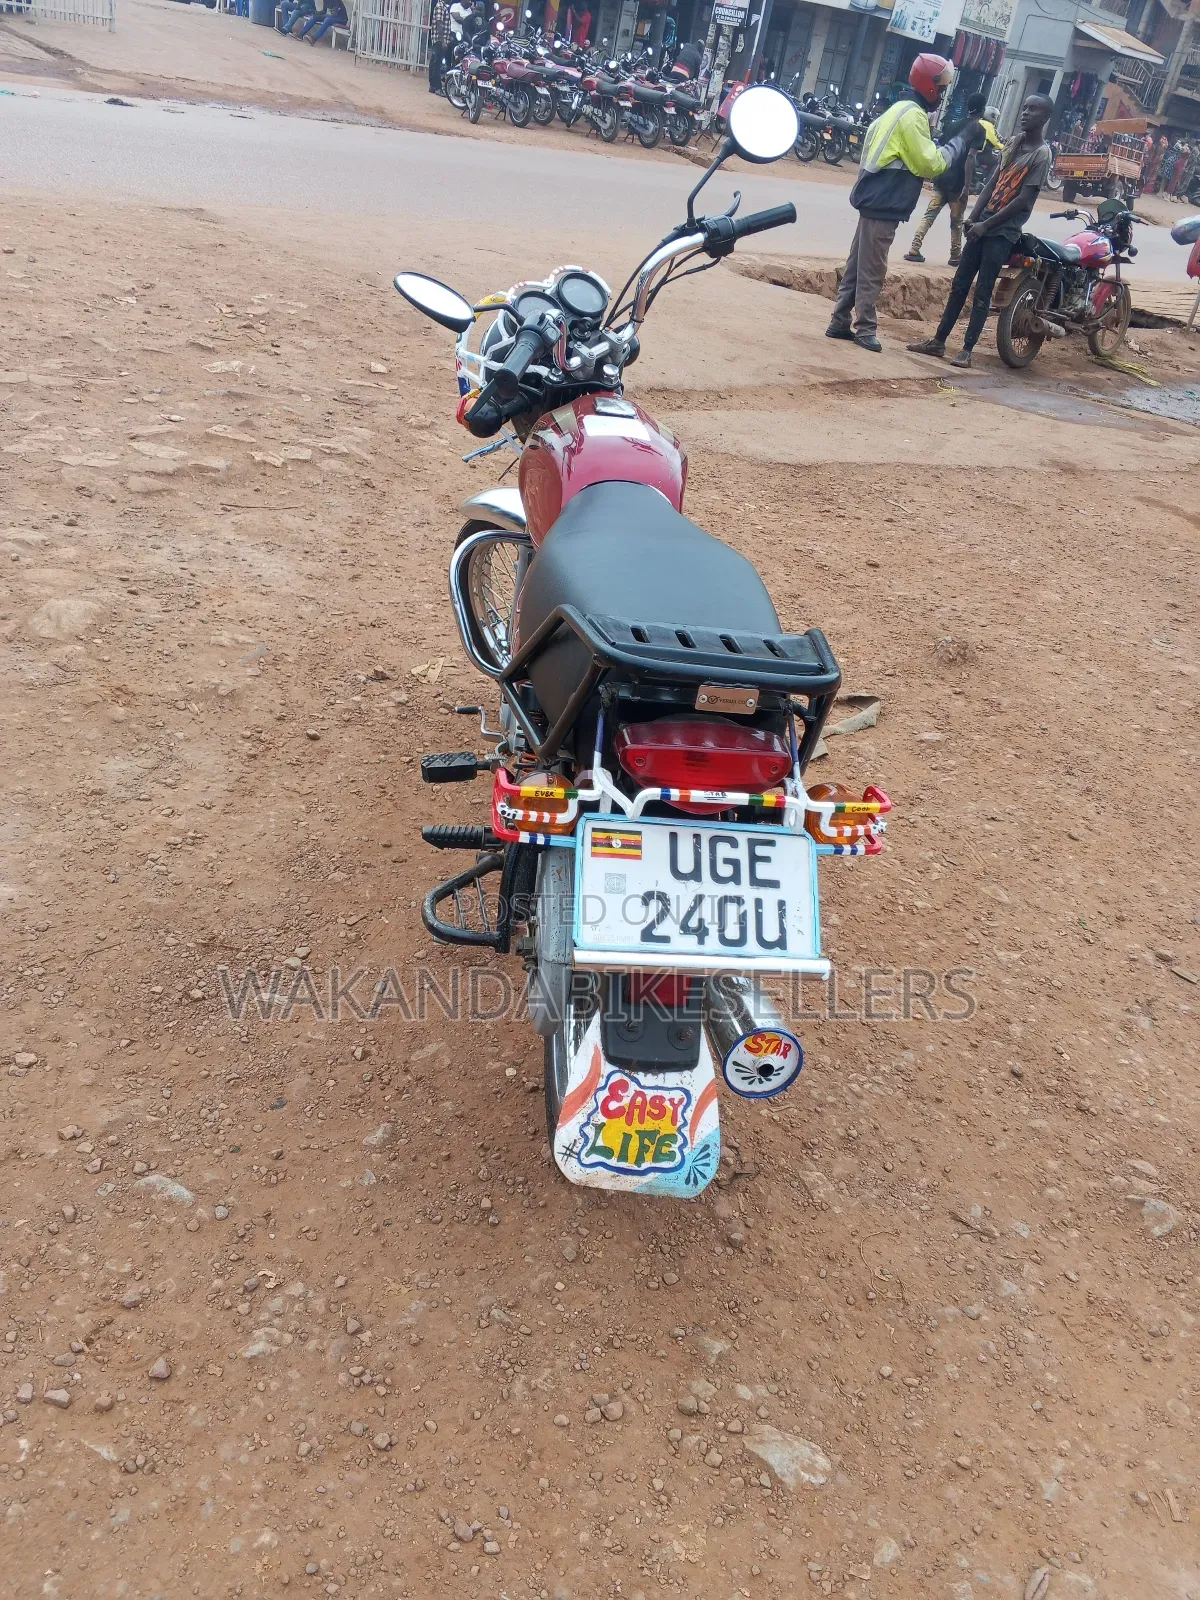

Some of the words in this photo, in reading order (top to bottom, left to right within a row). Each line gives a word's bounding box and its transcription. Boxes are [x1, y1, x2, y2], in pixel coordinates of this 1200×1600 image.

[669, 831, 781, 889] UGE
[640, 890, 788, 951] 240U
[744, 1032, 792, 1060] STAR
[599, 1078, 685, 1127] EASY
[585, 1121, 679, 1167] LIFE
